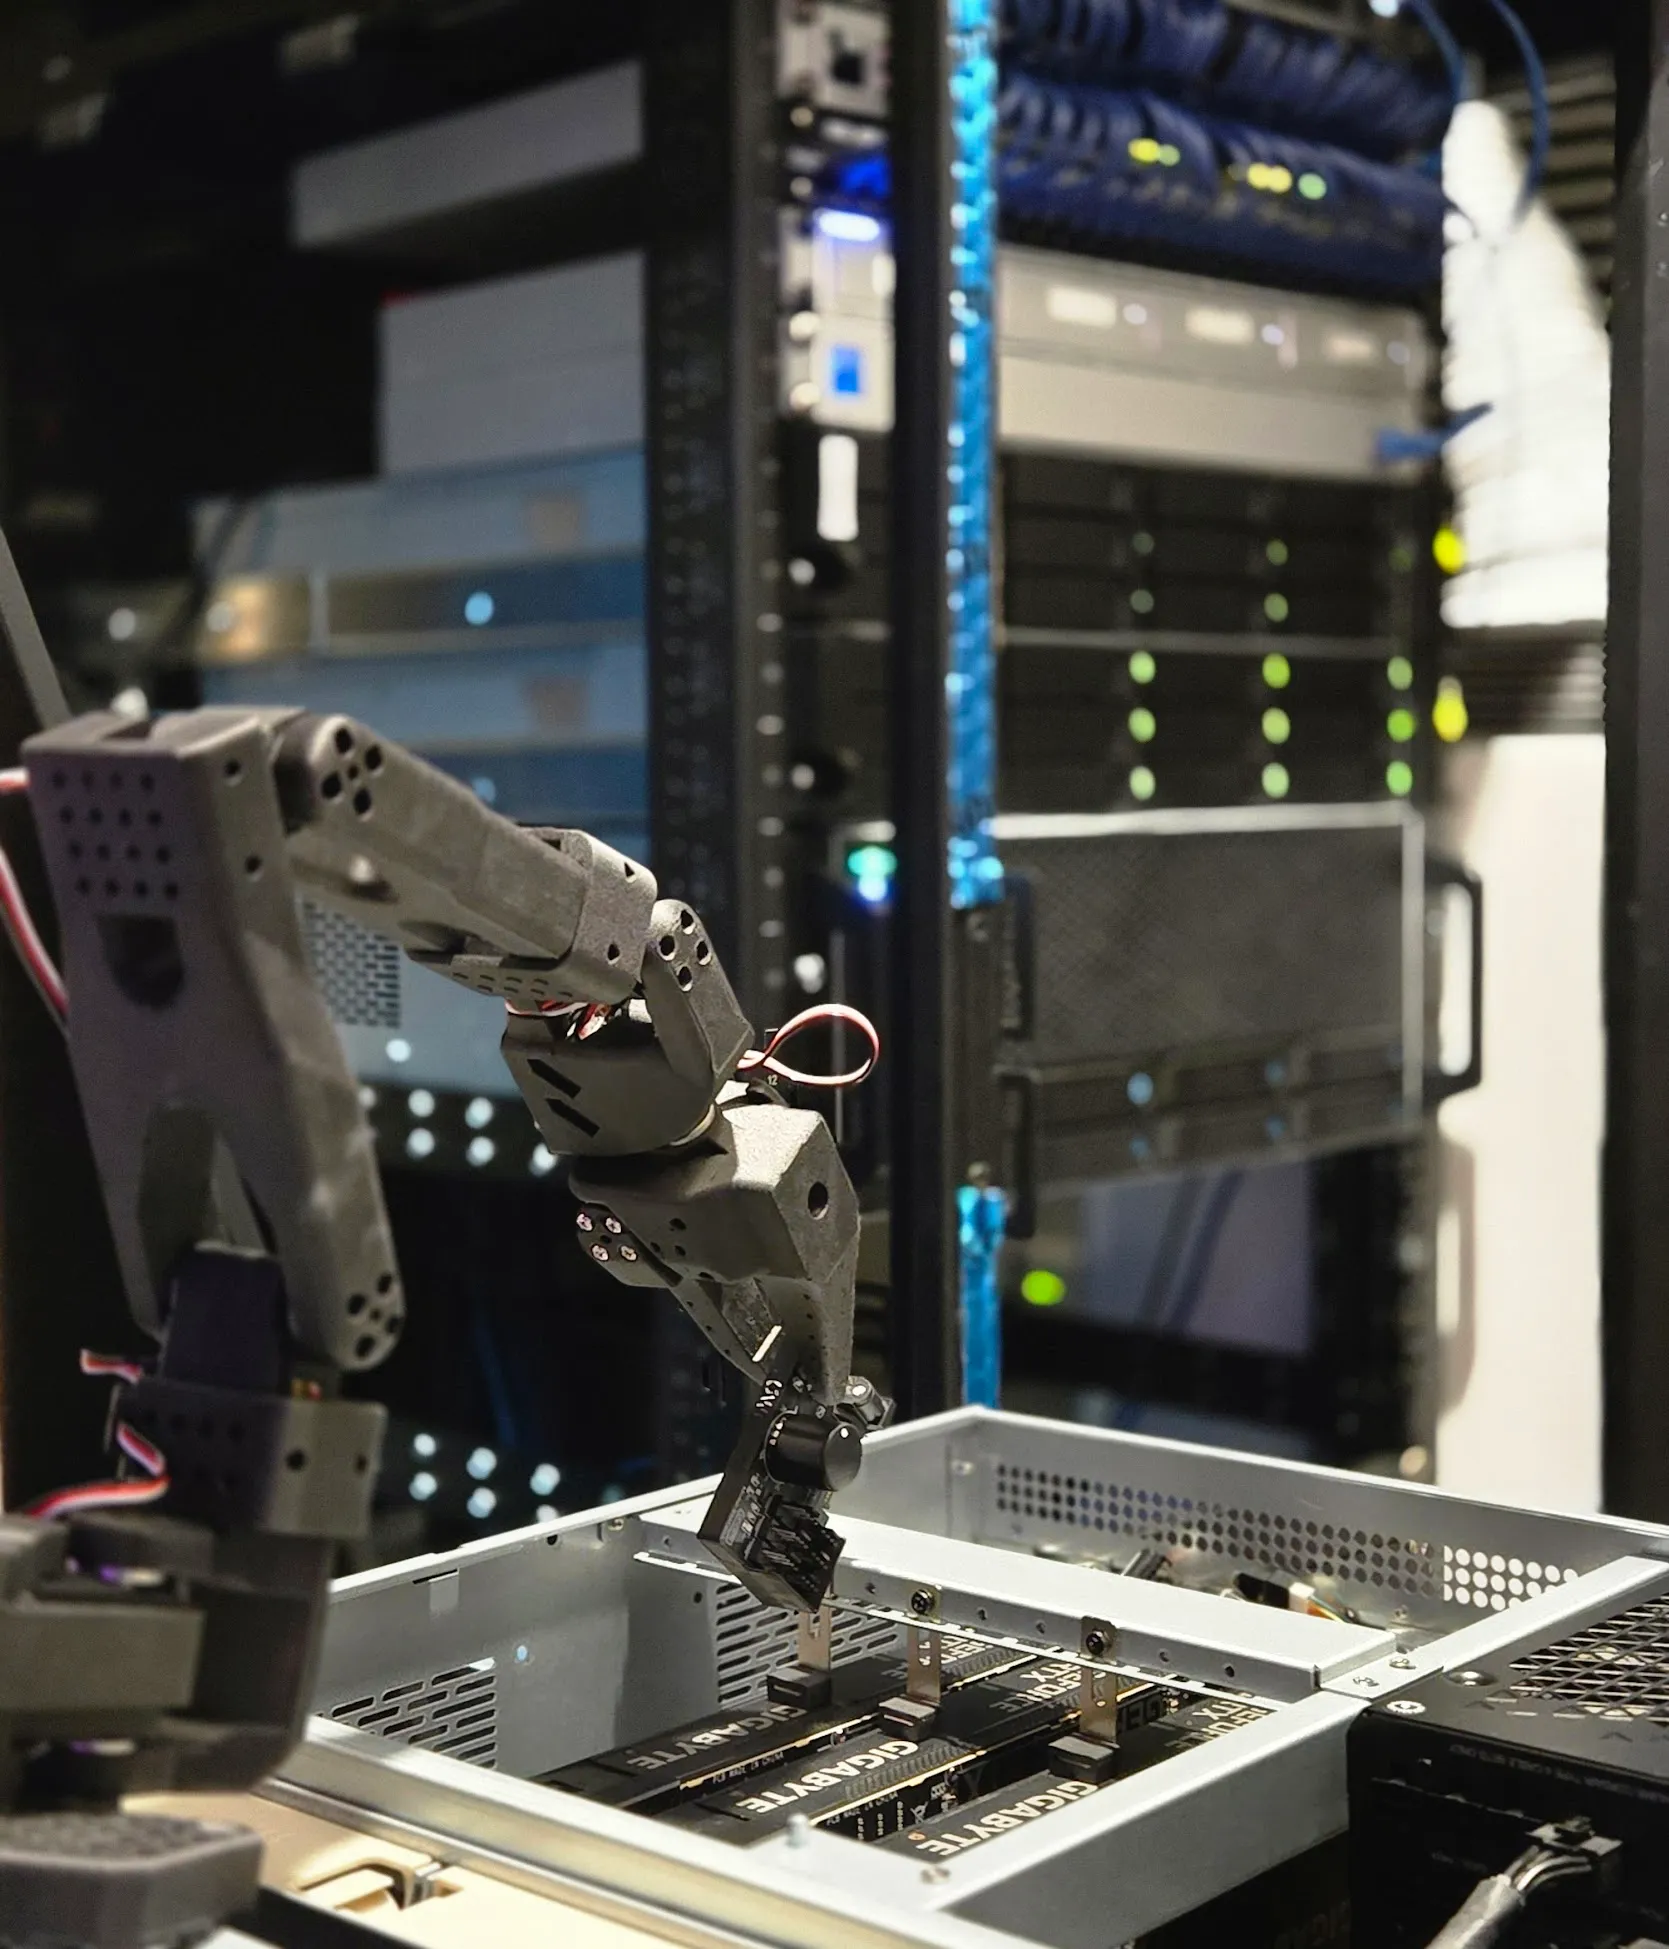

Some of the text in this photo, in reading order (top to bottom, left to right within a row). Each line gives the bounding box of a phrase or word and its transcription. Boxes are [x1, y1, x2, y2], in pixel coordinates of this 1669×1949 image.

[767, 1074, 778, 1086] 12
[626, 1704, 807, 1769] GIGABYTE
[736, 1740, 919, 1813] GIGABYTE
[916, 1780, 1098, 1856] GIGABYTE
